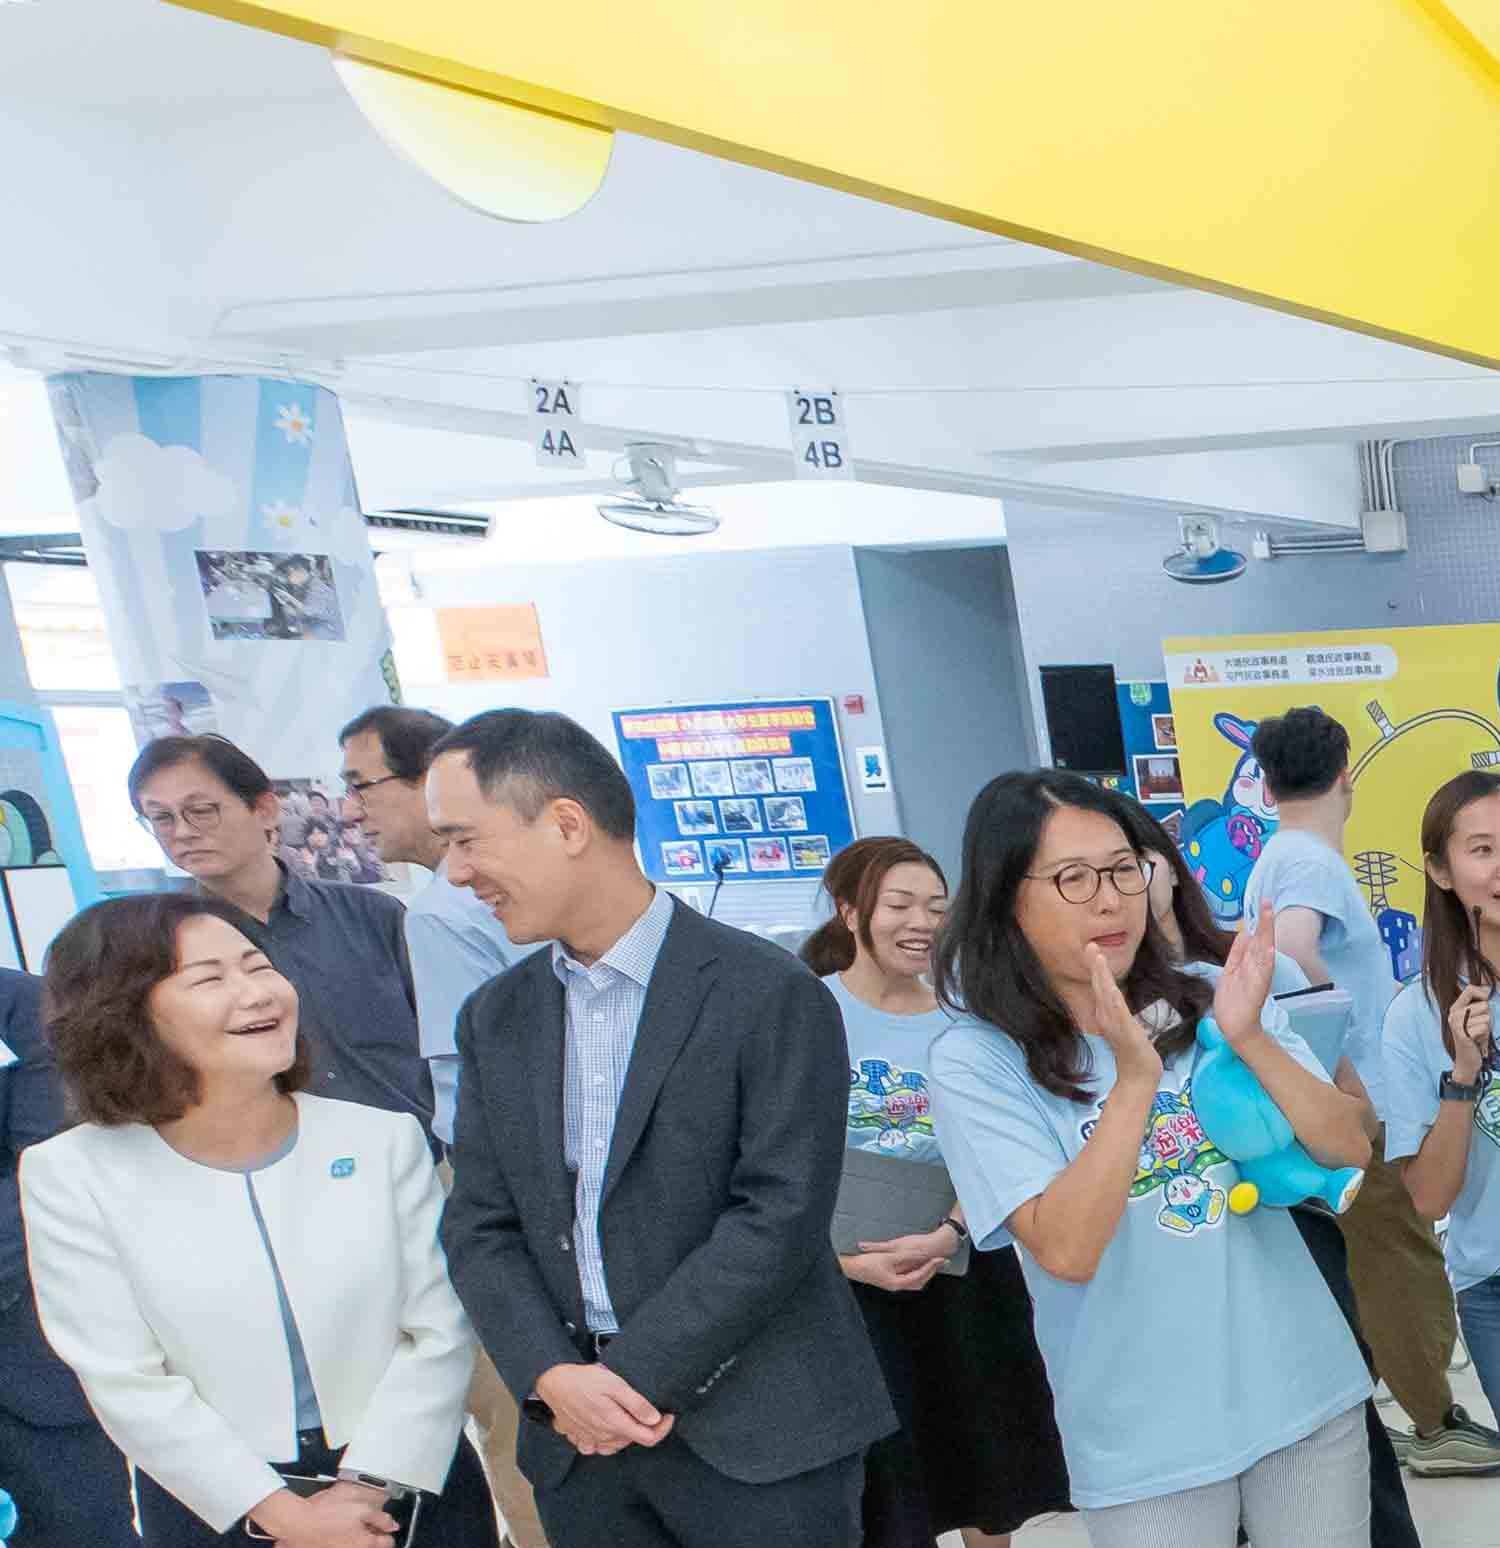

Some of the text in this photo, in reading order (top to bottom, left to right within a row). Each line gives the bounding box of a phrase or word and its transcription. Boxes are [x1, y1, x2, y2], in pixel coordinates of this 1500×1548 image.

[535, 387, 573, 415] 2A
[796, 398, 836, 425] 2B
[541, 429, 577, 457] 4A
[804, 441, 843, 468] 4B
